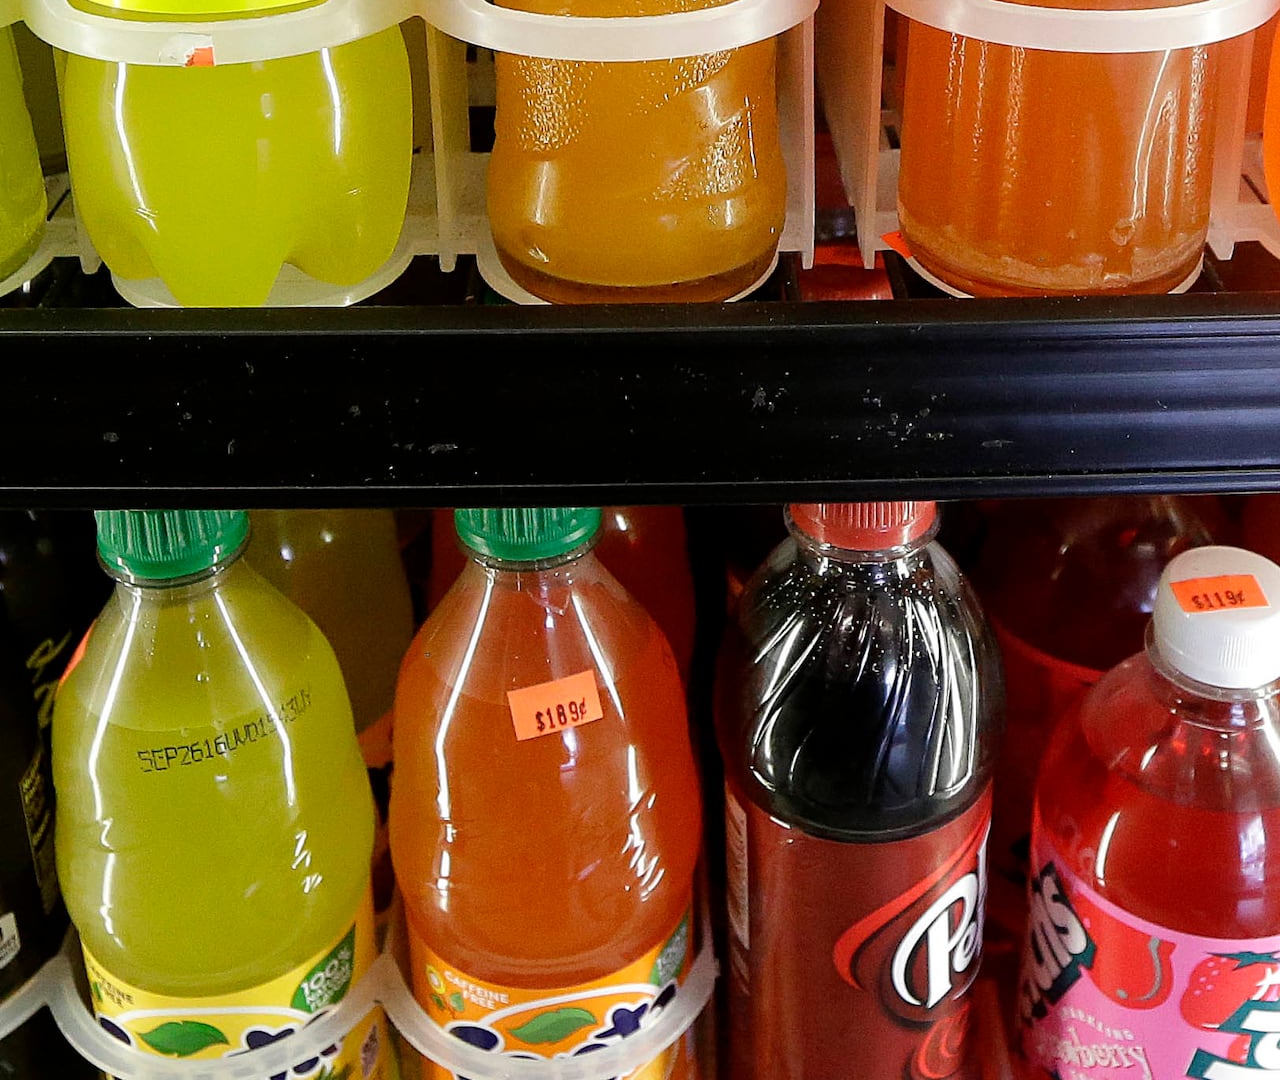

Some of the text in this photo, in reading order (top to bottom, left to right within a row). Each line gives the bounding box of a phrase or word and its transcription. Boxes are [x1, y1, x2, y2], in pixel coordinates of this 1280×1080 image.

[534, 695, 590, 735] $189¢
[444, 970, 510, 1005] CAFFEINE
[461, 989, 497, 1011] FREE
